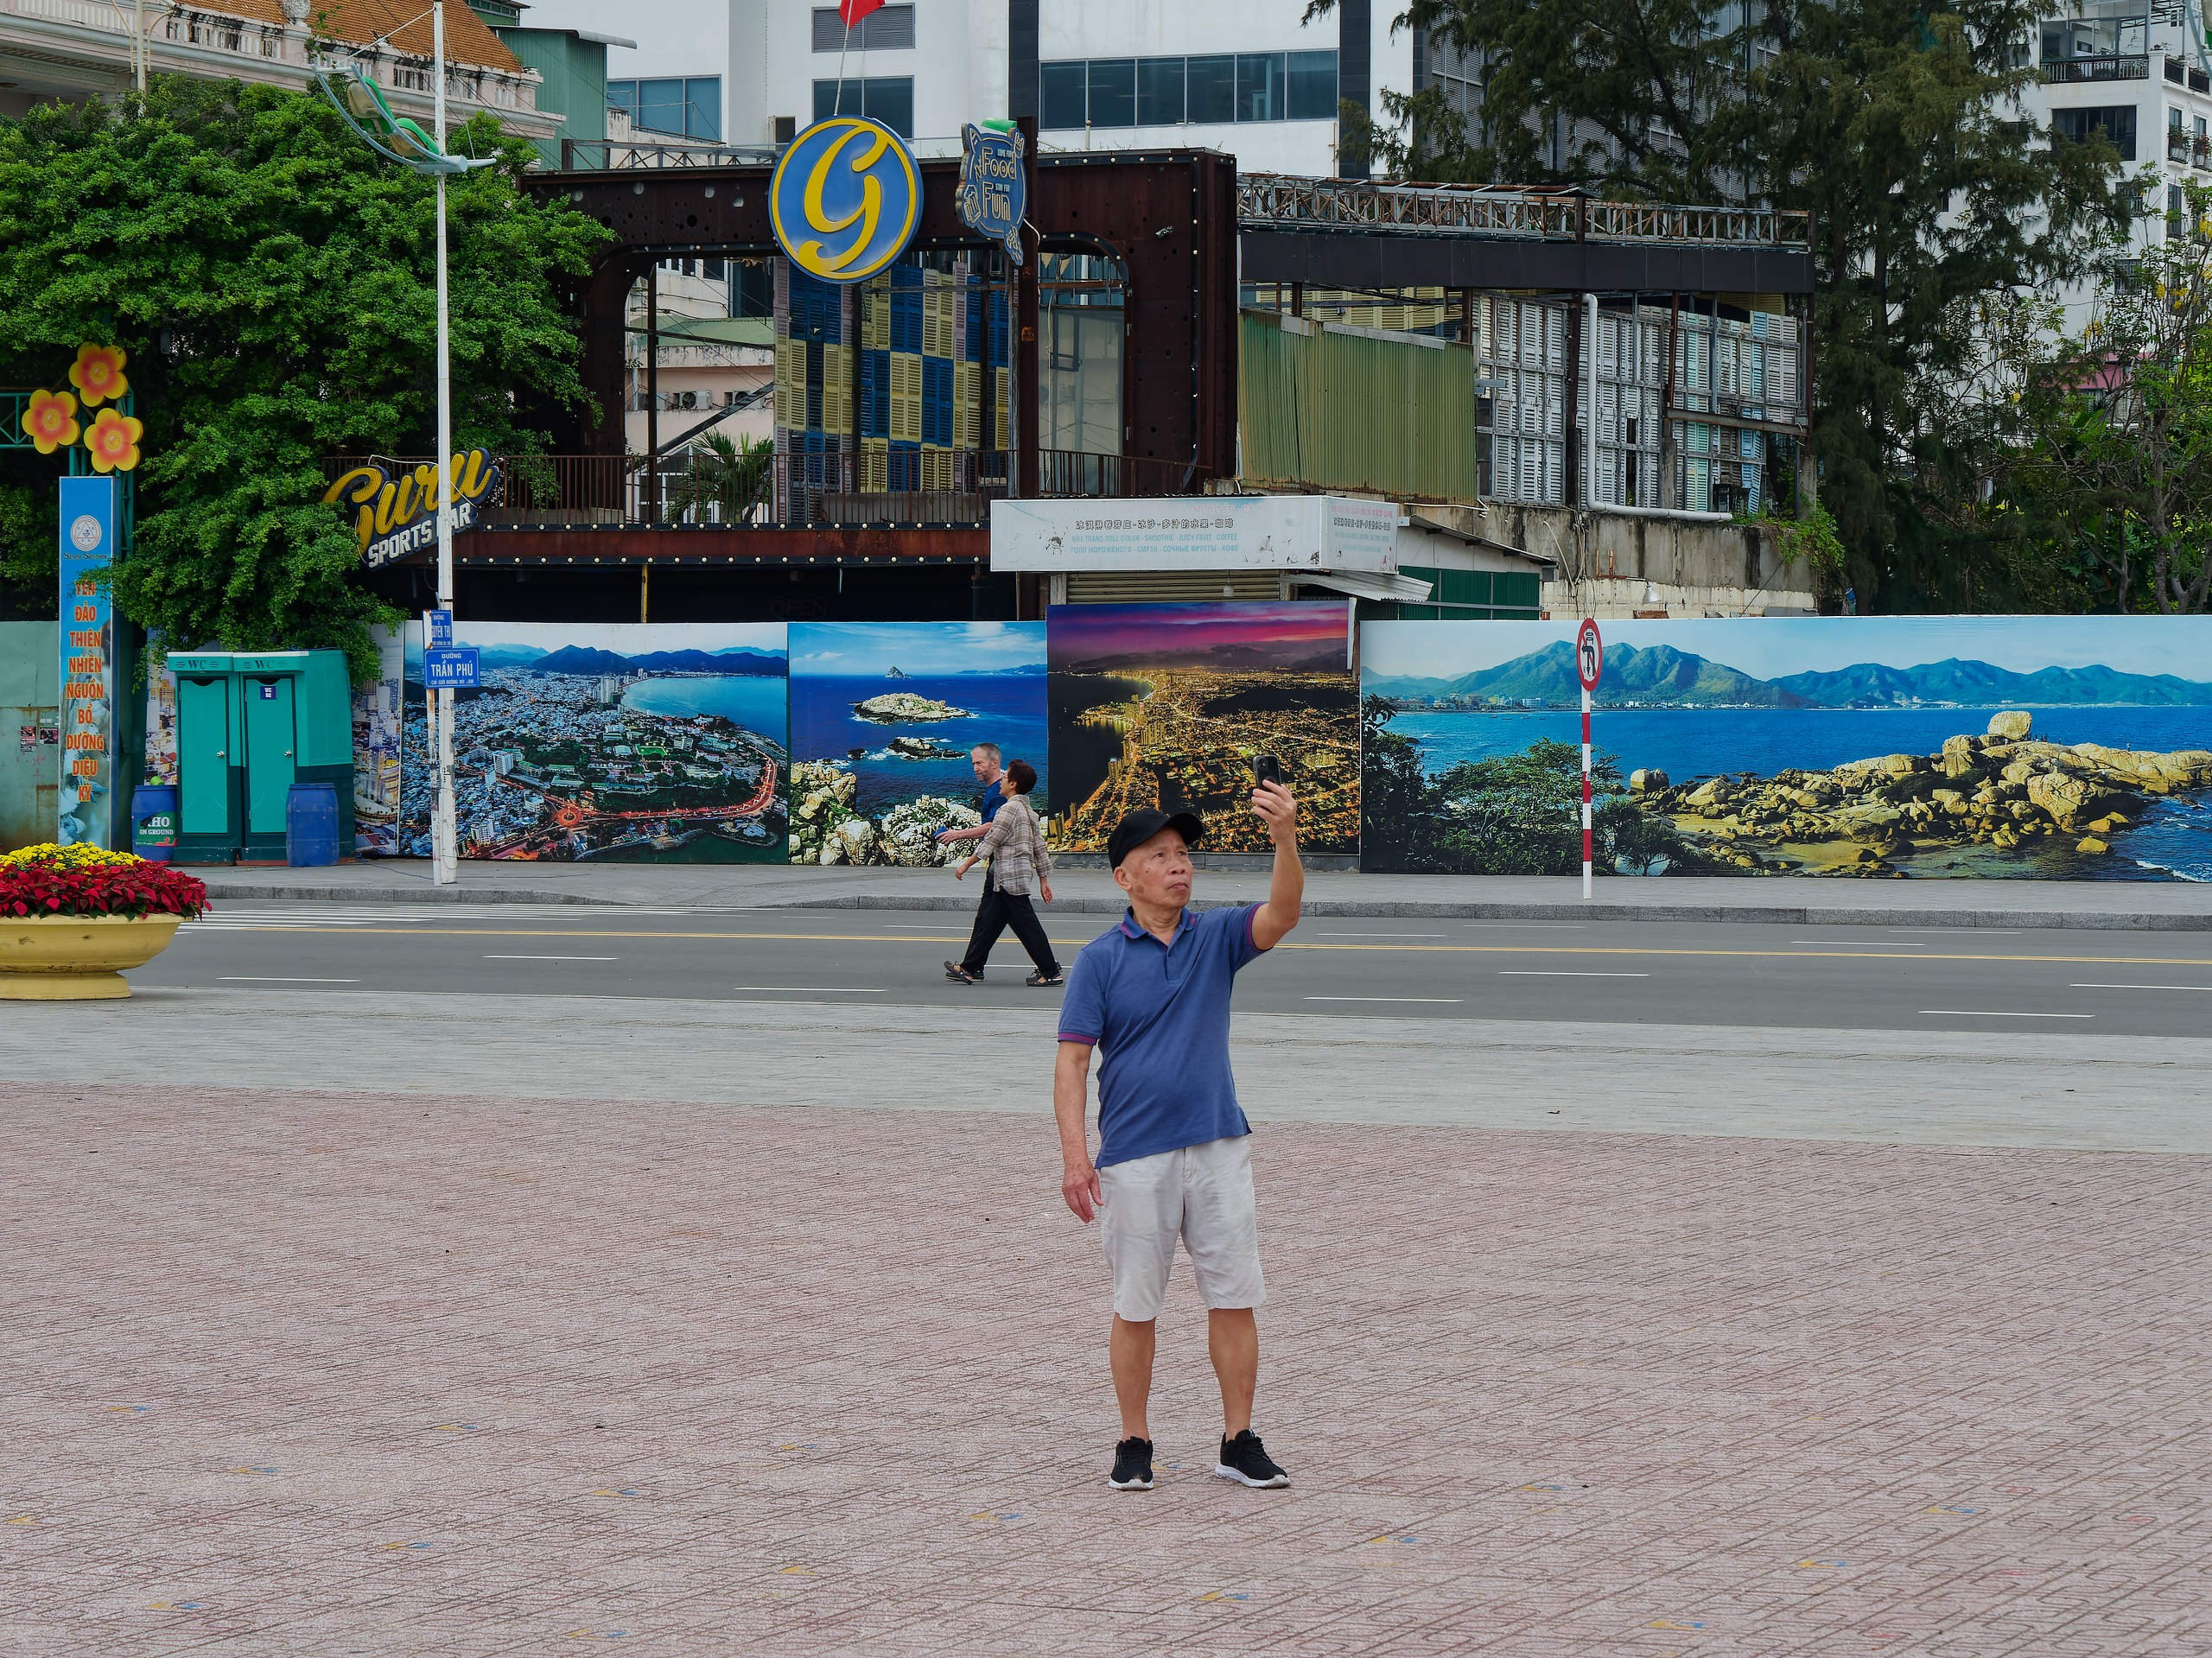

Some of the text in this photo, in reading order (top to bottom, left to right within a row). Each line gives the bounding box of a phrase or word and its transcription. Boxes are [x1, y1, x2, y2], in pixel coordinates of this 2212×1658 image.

[982, 147, 1017, 181] Food
[982, 181, 1011, 221] Fun
[368, 519, 432, 568] SPORTS
[1144, 533, 1173, 542] SMOOTHIE
[1179, 533, 1194, 542] JUICY
[74, 600, 96, 622] ĐẢO
[69, 628, 101, 648] THIÊN
[68, 654, 102, 673] NHIÊN
[188, 659, 207, 670] WC
[255, 660, 275, 670] WC
[431, 659, 473, 677] TRẦN PHÚ
[66, 730, 104, 751] DƯỠNG
[73, 757, 97, 780] DIỆU
